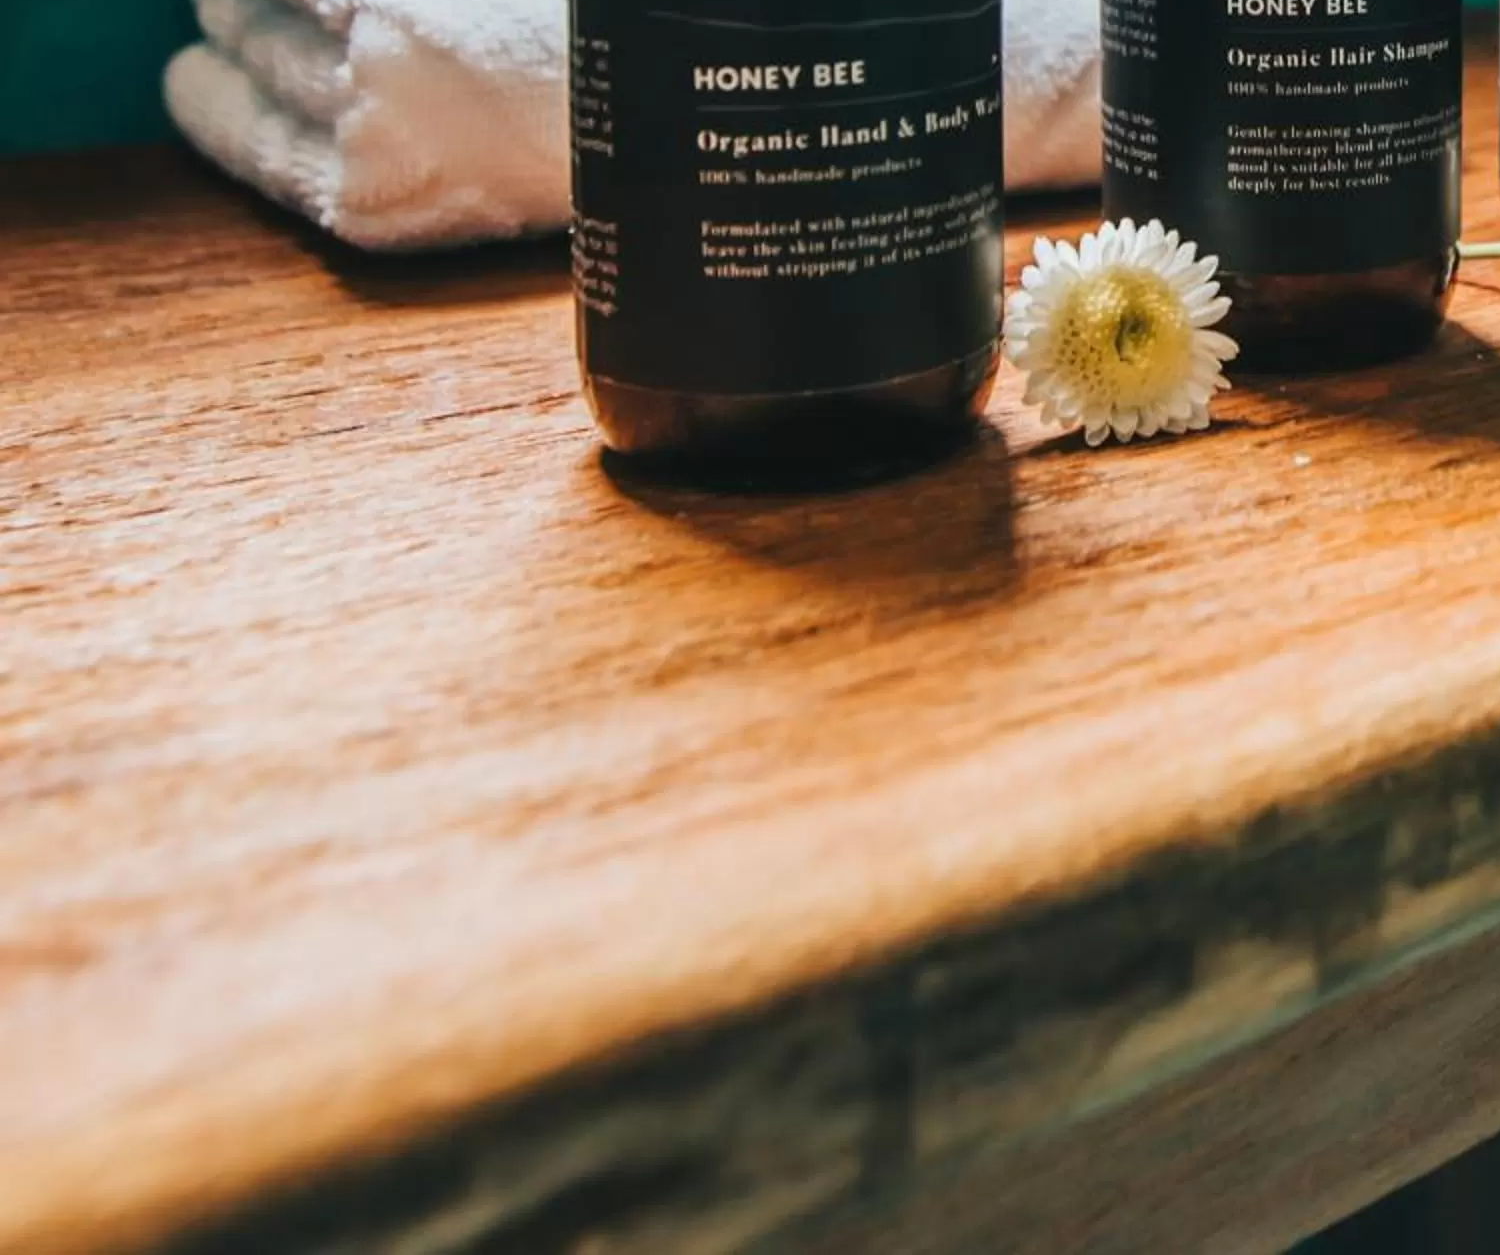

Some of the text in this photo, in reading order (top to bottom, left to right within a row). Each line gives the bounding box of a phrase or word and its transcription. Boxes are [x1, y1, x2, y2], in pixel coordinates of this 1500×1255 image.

[1227, 47, 1321, 73] Organic
[1330, 46, 1375, 66] Hair
[693, 60, 866, 91] HONEY BEE
[1275, 80, 1349, 95] handmade
[1355, 76, 1409, 96] products
[697, 126, 809, 158] Organic
[821, 118, 888, 146] Hand
[898, 115, 915, 138] &
[925, 104, 969, 132] Body
[1227, 124, 1277, 139] Gentle
[1281, 124, 1351, 139] cleansing
[1228, 142, 1328, 158] aromatherapy
[1335, 140, 1373, 154] blend
[699, 156, 923, 185] 100% handmade products
[1291, 158, 1349, 173] suitable
[1377, 153, 1393, 168] all
[1227, 173, 1391, 194] deeply for best results
[701, 217, 801, 237] Formulated
[808, 213, 846, 233] with
[852, 206, 908, 229] natural
[701, 240, 747, 257] leave
[753, 240, 783, 257] the
[789, 238, 826, 254] skin
[832, 231, 889, 252] feeling
[704, 261, 770, 278] without
[776, 257, 858, 280] stripping
[864, 253, 875, 268] it
[881, 247, 897, 264] of
